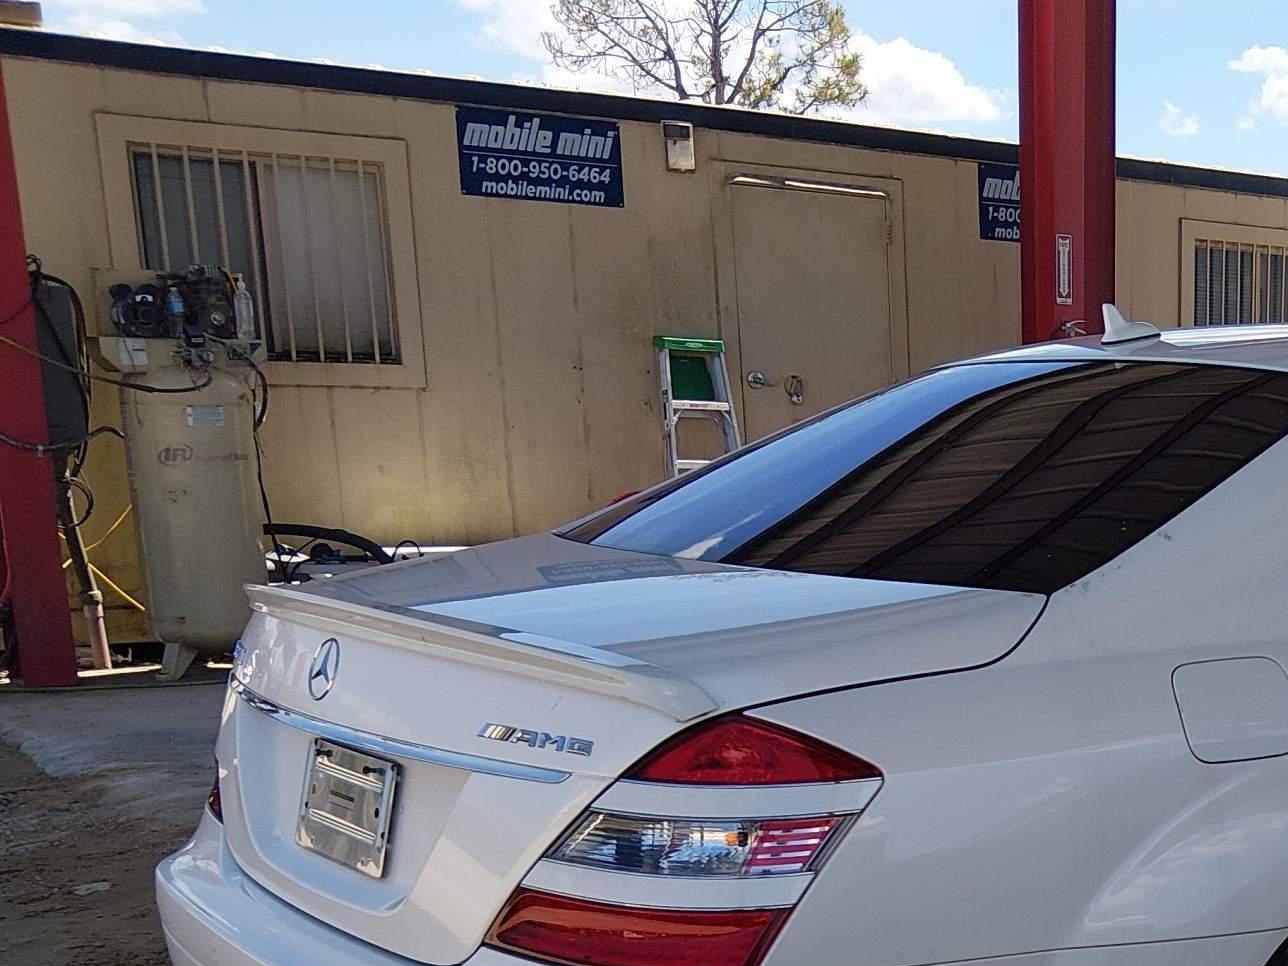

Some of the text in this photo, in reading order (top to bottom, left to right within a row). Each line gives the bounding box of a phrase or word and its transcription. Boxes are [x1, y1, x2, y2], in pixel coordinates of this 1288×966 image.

[463, 115, 614, 159] mobile mini
[471, 156, 610, 184] 1-800-950-6464
[481, 179, 605, 203] mobilemini.com
